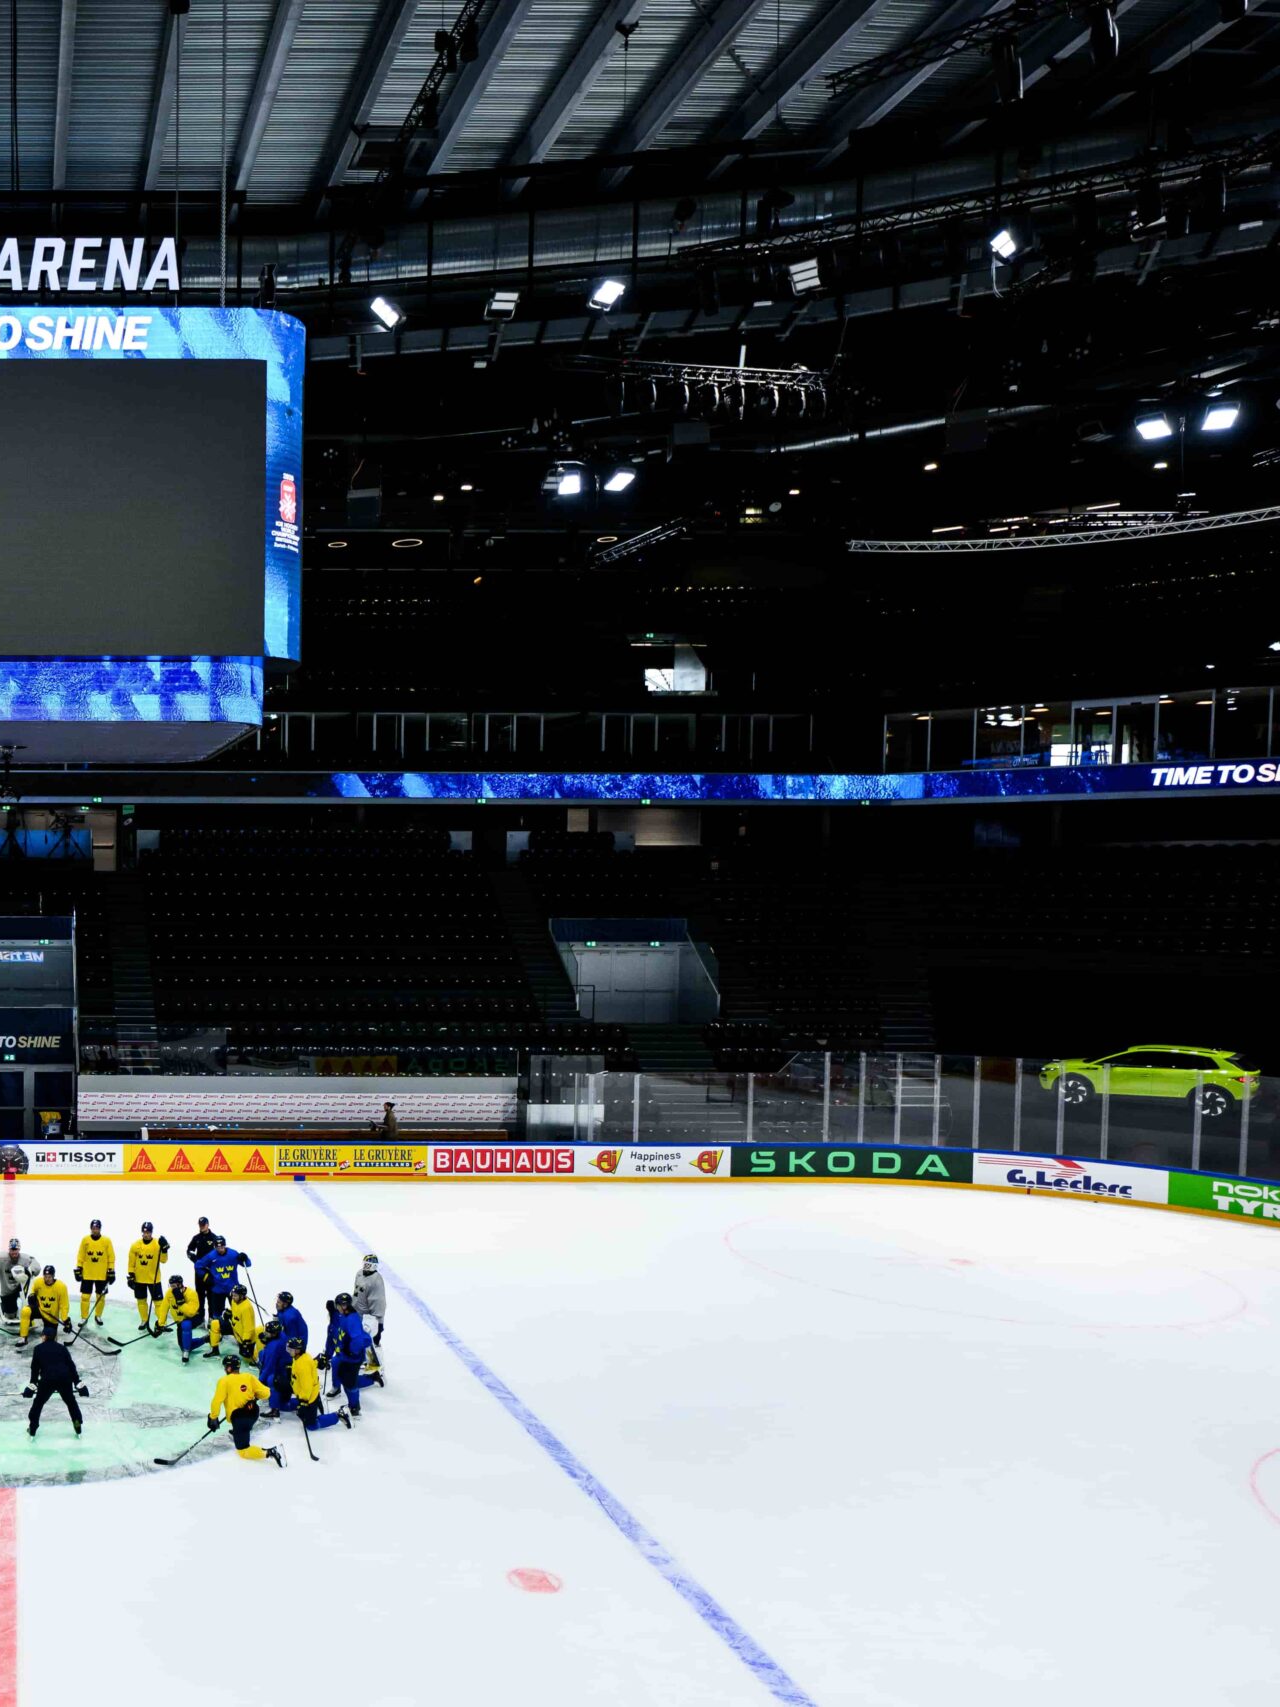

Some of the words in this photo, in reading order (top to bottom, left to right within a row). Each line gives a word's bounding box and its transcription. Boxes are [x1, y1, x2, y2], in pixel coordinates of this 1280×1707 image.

[24, 314, 153, 351] SHINE
[1150, 765, 1215, 787] TIME
[1217, 763, 1256, 784] TO
[17, 1035, 62, 1049] SHINE
[58, 1151, 117, 1163] TISSOT
[278, 1148, 290, 1161] LE
[292, 1146, 338, 1161] GRUYÈRE
[353, 1148, 365, 1161] LE
[367, 1146, 413, 1161] GRUYÈRE
[435, 1150, 573, 1171] BAUHAUS
[630, 1150, 682, 1162] Happiness
[132, 1155, 153, 1171] Sika
[170, 1155, 191, 1171] Sika
[208, 1155, 229, 1171] Sika
[246, 1155, 267, 1171] Sika
[635, 1163, 646, 1173] at
[1212, 1180, 1280, 1202] nok
[1212, 1194, 1280, 1220] TYR
